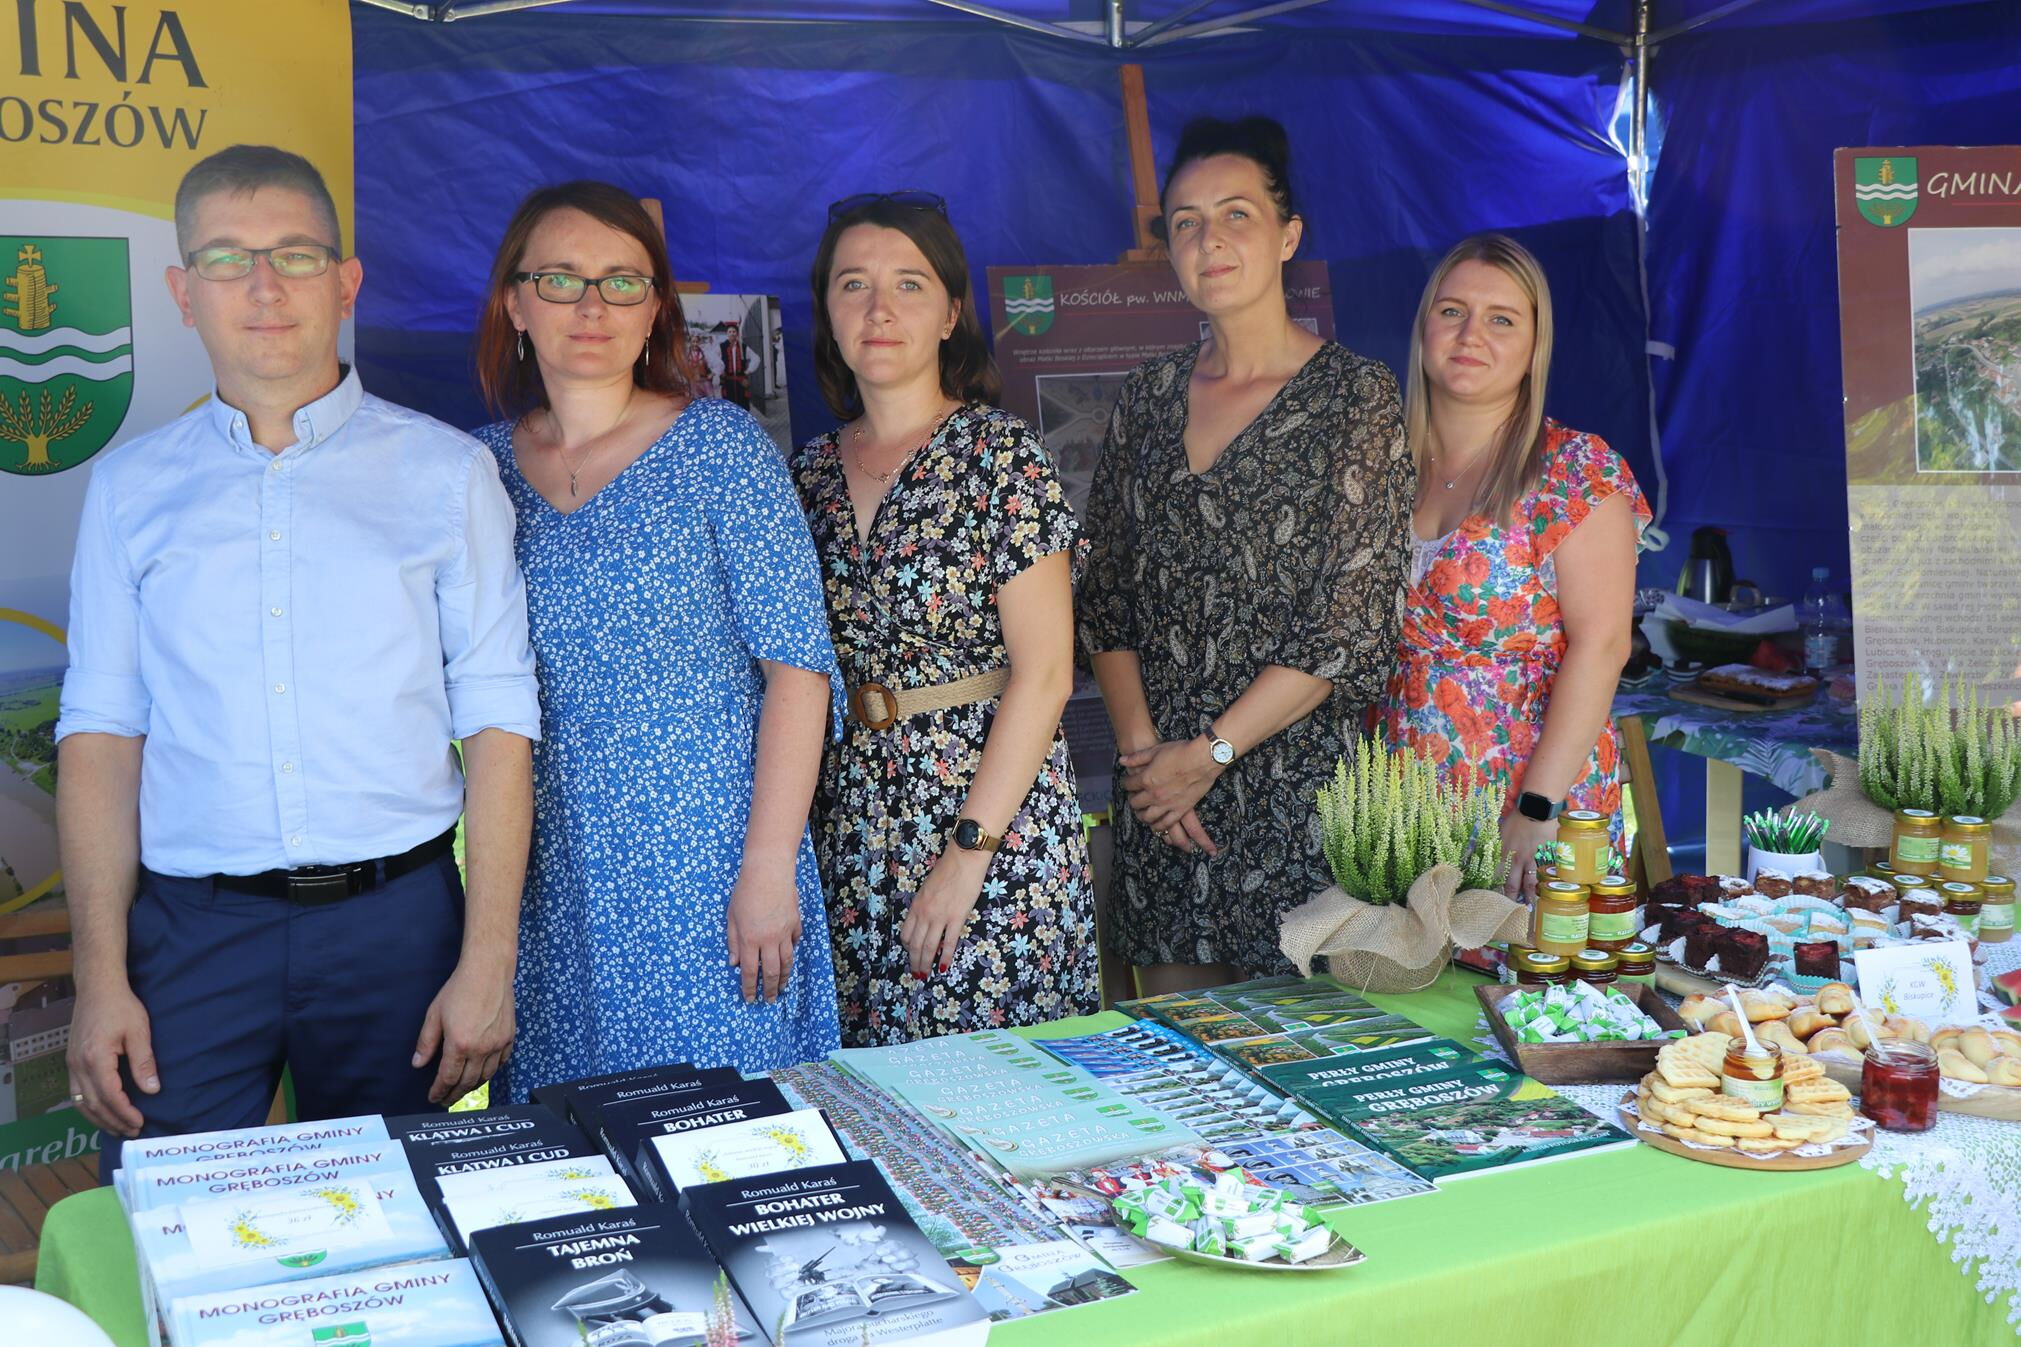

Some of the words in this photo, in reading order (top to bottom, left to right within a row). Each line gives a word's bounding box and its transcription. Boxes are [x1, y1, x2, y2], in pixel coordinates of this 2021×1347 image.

[1060, 290, 1122, 306] KOŚCIÓŁ
[1307, 1067, 1360, 1080] PERŁY
[1361, 1056, 1417, 1073] GMINY
[616, 1084, 669, 1098] Romuald
[670, 1079, 702, 1090] Karaś
[940, 1078, 1023, 1096] GAZETA
[1352, 1087, 1407, 1104] PERŁY
[1408, 1079, 1465, 1095] GMINY
[1368, 1083, 1501, 1113] GRĘBOSZÓW
[651, 1099, 706, 1118] Romuald
[706, 1094, 740, 1109] Karaś
[959, 1094, 1043, 1116] GAZETA
[408, 1128, 480, 1142] KLĄTWA
[496, 1121, 535, 1132] CUD
[422, 1116, 475, 1128] Romuald
[477, 1113, 511, 1123] Karaś
[663, 1108, 748, 1134] BOHATER
[991, 1112, 1076, 1137] GAZETA
[145, 1135, 291, 1158] MONOGRAFIA
[296, 1127, 364, 1141] GMINY
[451, 1145, 507, 1159] Romuald
[509, 1138, 544, 1150] Karaś
[1021, 1124, 1109, 1149] GAZETA
[528, 1149, 570, 1162] CUD
[156, 1162, 308, 1187] MONOGRAFIA
[313, 1152, 383, 1168] GMINY
[208, 1170, 340, 1194] GRĘBOSZÓW
[741, 1181, 798, 1199] Romuald
[799, 1176, 838, 1192] Karaś
[754, 1192, 844, 1216] BOHATER
[532, 1222, 595, 1242] Romuald
[598, 1217, 637, 1233] Karaś
[729, 1211, 816, 1237] WIELKIEJ
[818, 1203, 886, 1224] WOJNY
[546, 1233, 641, 1258] TAJEMNA
[572, 1248, 634, 1271] BROŃ
[199, 1286, 368, 1319] MONOGRAFIA
[374, 1273, 451, 1293] GMINY
[258, 1294, 405, 1325] GRĘBOSZÓW
